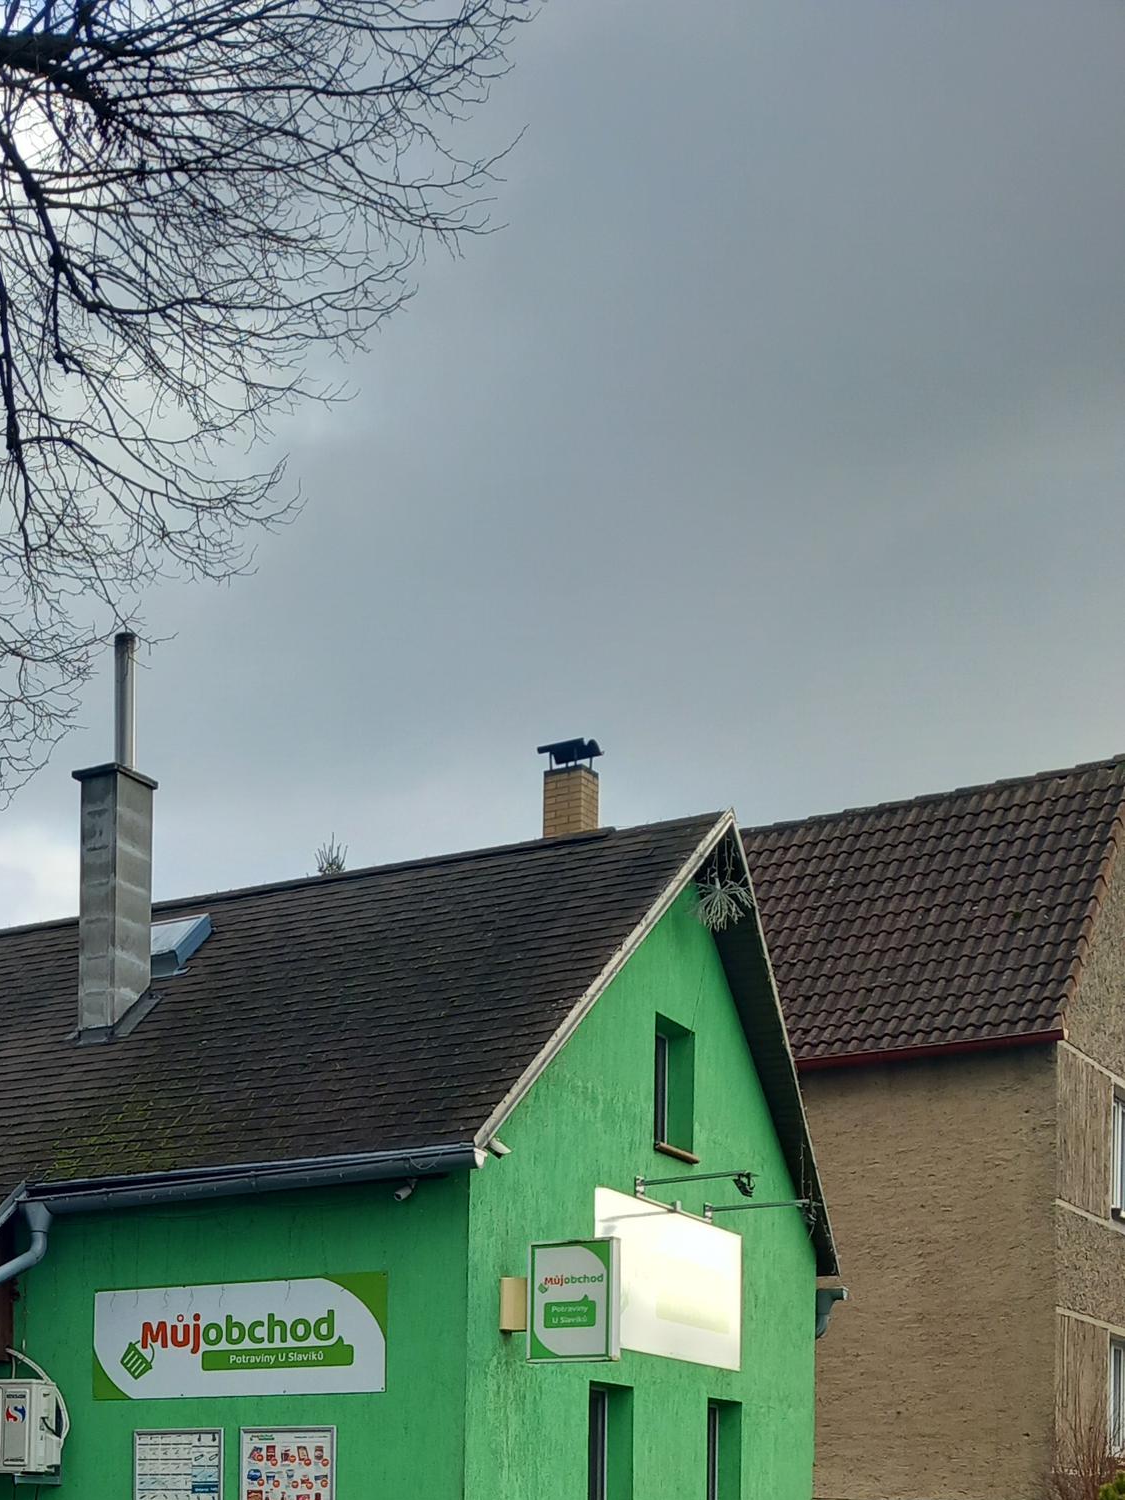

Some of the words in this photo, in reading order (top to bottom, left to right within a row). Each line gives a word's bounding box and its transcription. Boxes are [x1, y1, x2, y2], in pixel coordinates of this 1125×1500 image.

[544, 1273, 604, 1287] Můjobchod
[551, 1304, 589, 1314] Potraviny
[551, 1316, 559, 1324] U
[141, 1309, 335, 1354] Můjobchod
[229, 1353, 276, 1365] Potraviny
[278, 1353, 287, 1362] U
[288, 1351, 324, 1362] Slavíků
